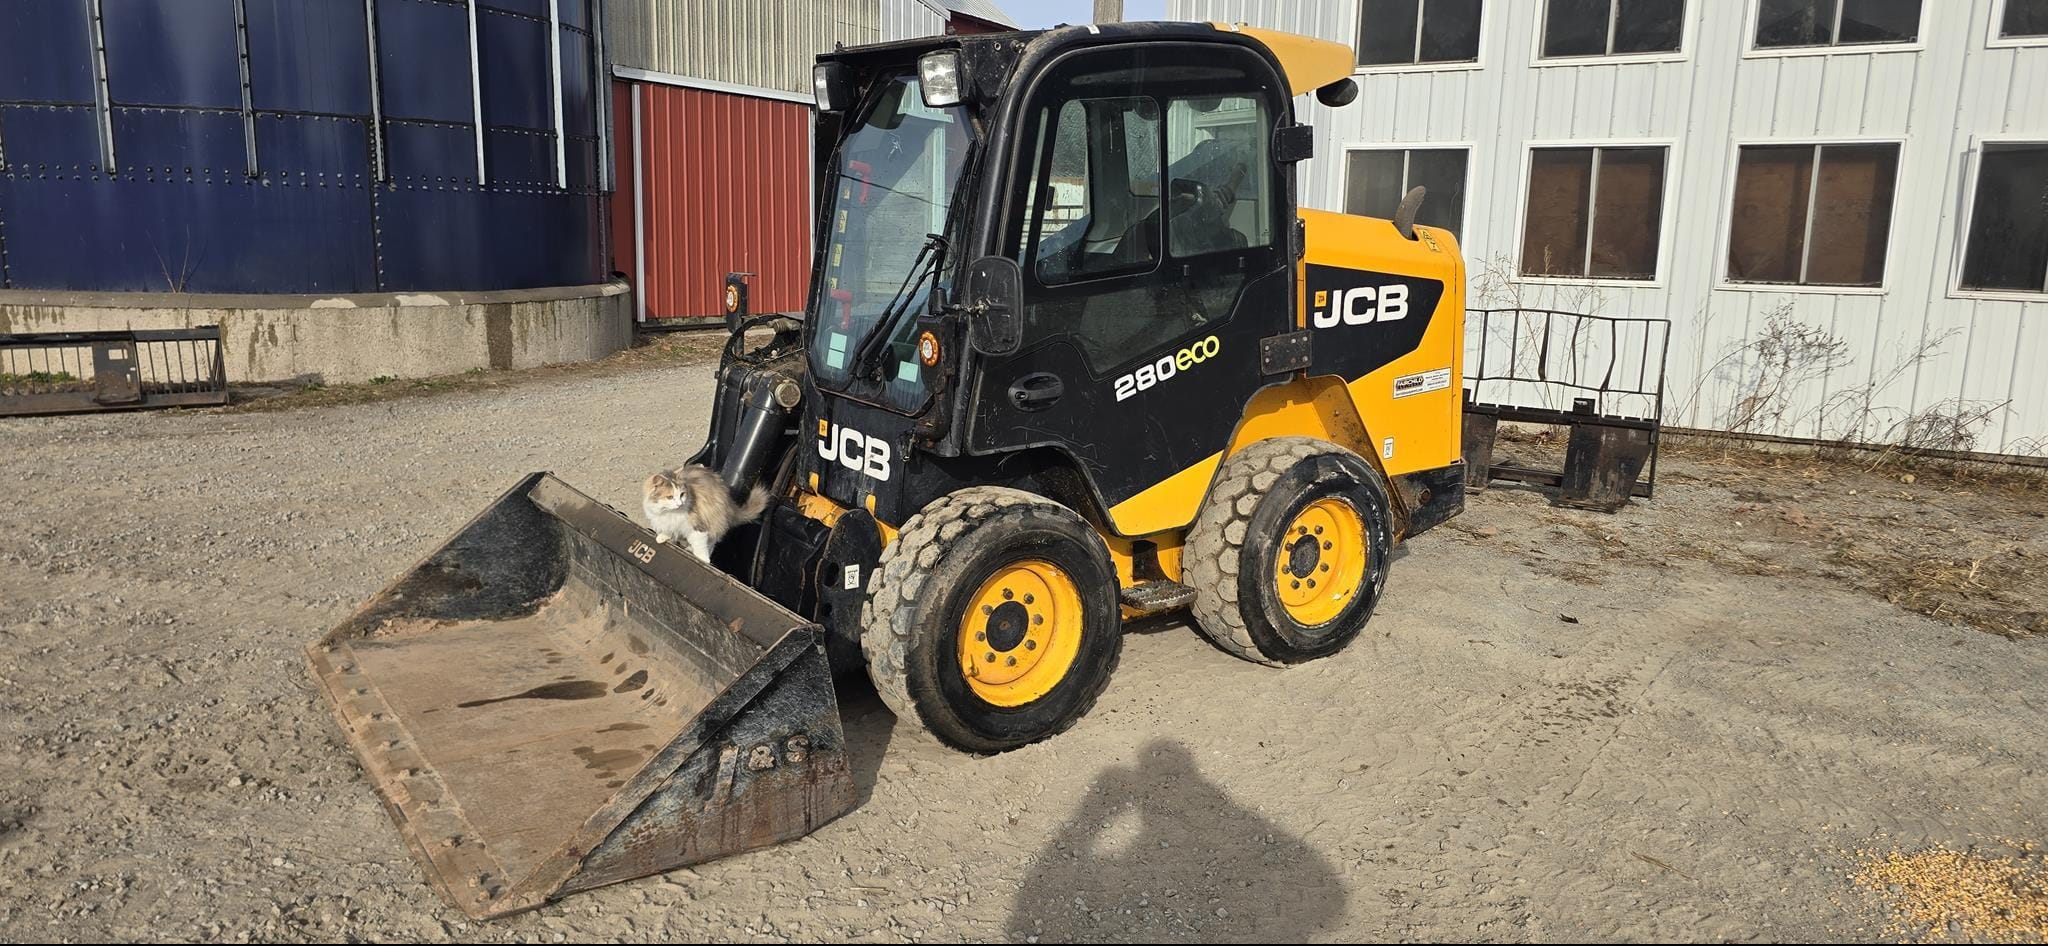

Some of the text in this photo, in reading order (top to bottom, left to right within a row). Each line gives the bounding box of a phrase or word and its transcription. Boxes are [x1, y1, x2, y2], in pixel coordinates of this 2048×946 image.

[1314, 284, 1408, 329] JCB
[818, 419, 891, 482] JCB
[627, 539, 657, 563] JCB
